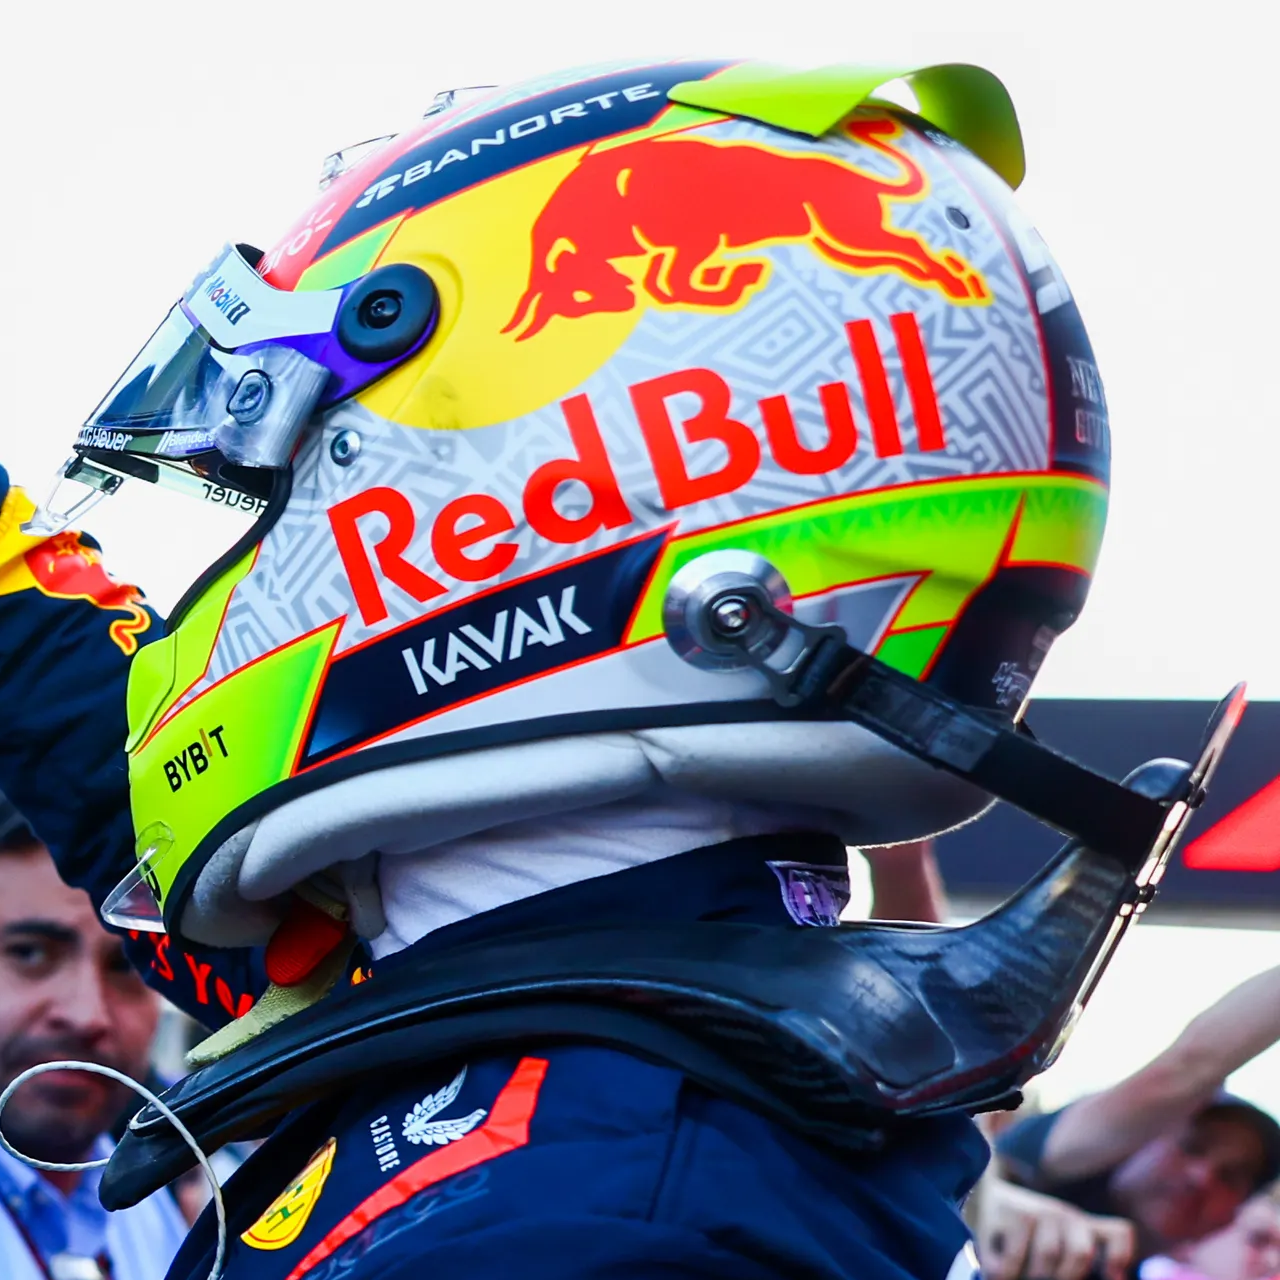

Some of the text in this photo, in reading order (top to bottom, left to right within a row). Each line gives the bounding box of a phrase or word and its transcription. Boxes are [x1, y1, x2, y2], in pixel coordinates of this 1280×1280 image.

[401, 83, 661, 187] BANORTE
[327, 311, 944, 628] Red Bull
[402, 586, 592, 694] KAVAK
